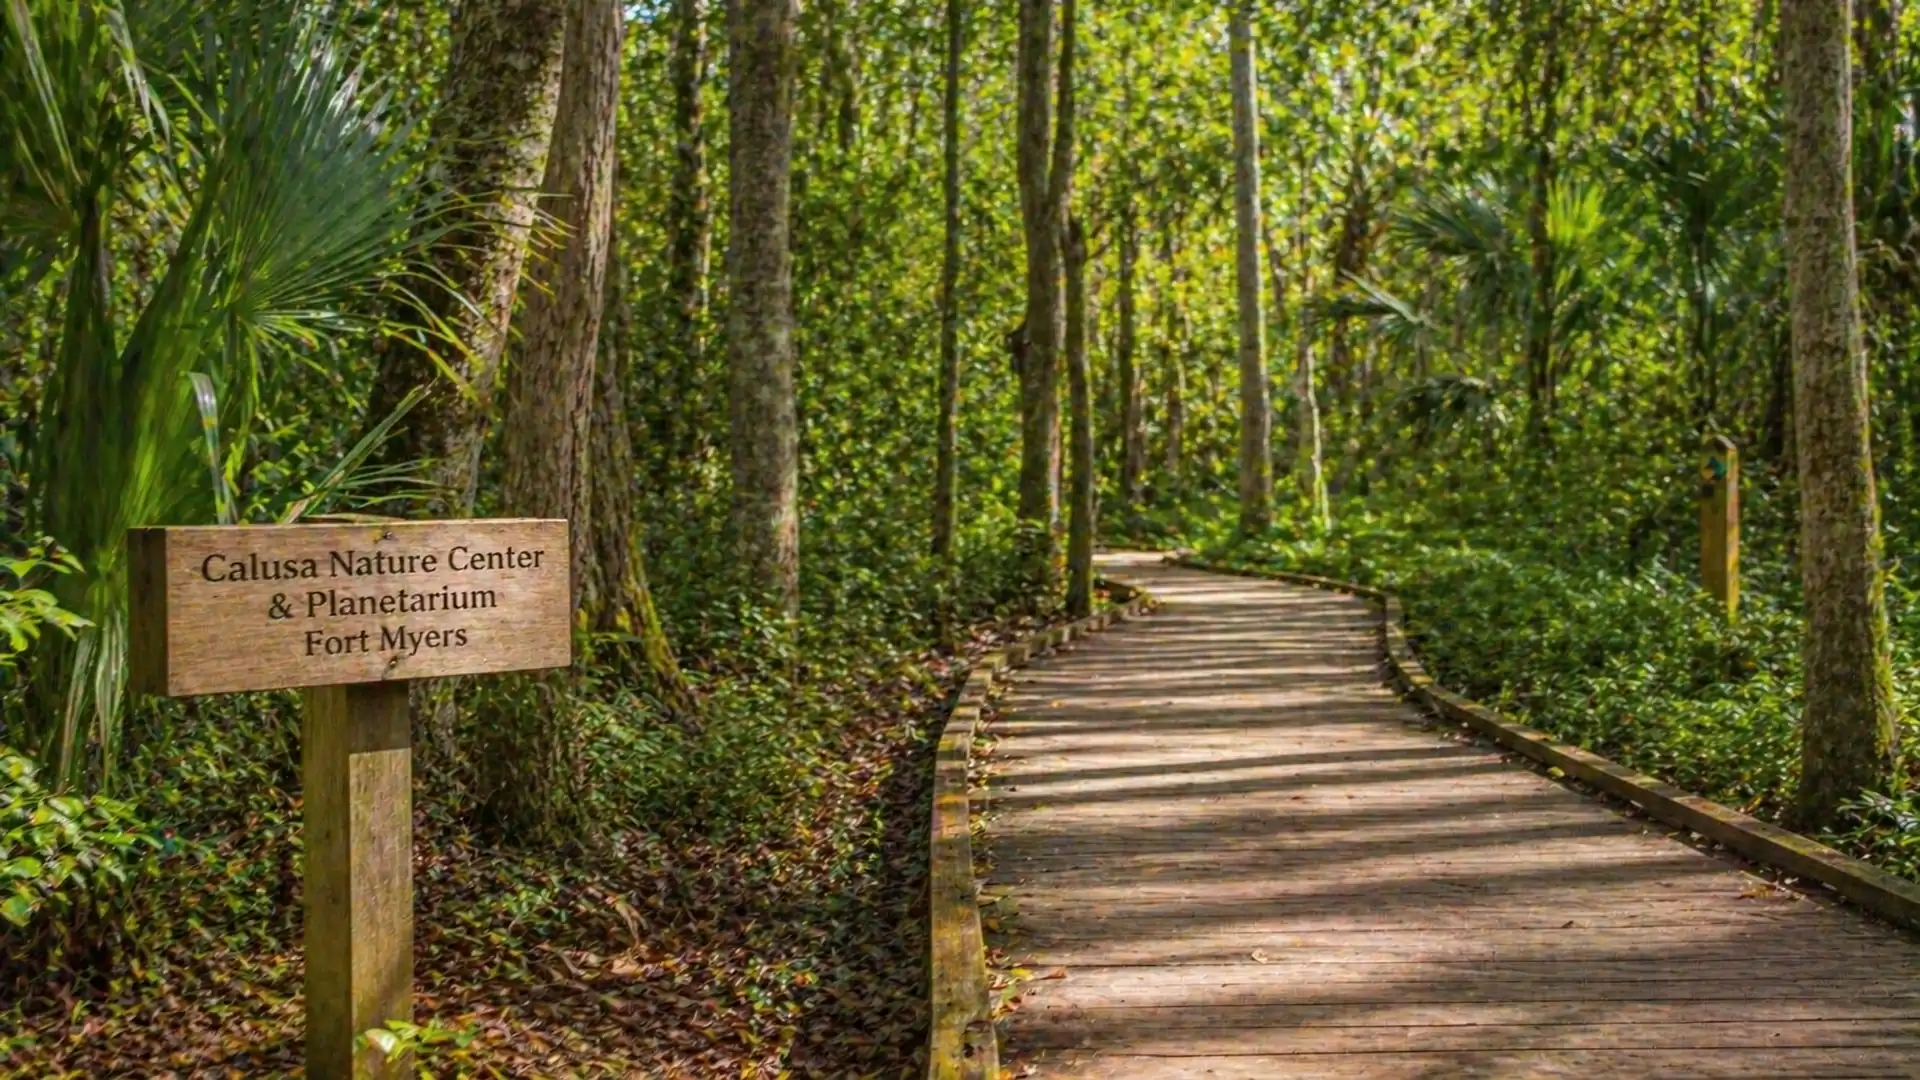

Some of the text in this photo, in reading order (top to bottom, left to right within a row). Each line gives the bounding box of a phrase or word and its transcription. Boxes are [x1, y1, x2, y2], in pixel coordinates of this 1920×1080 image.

[201, 546, 545, 582] Calusa Nature Center
[268, 585, 497, 620] & Planetarium
[304, 625, 468, 656] Fort Myers
